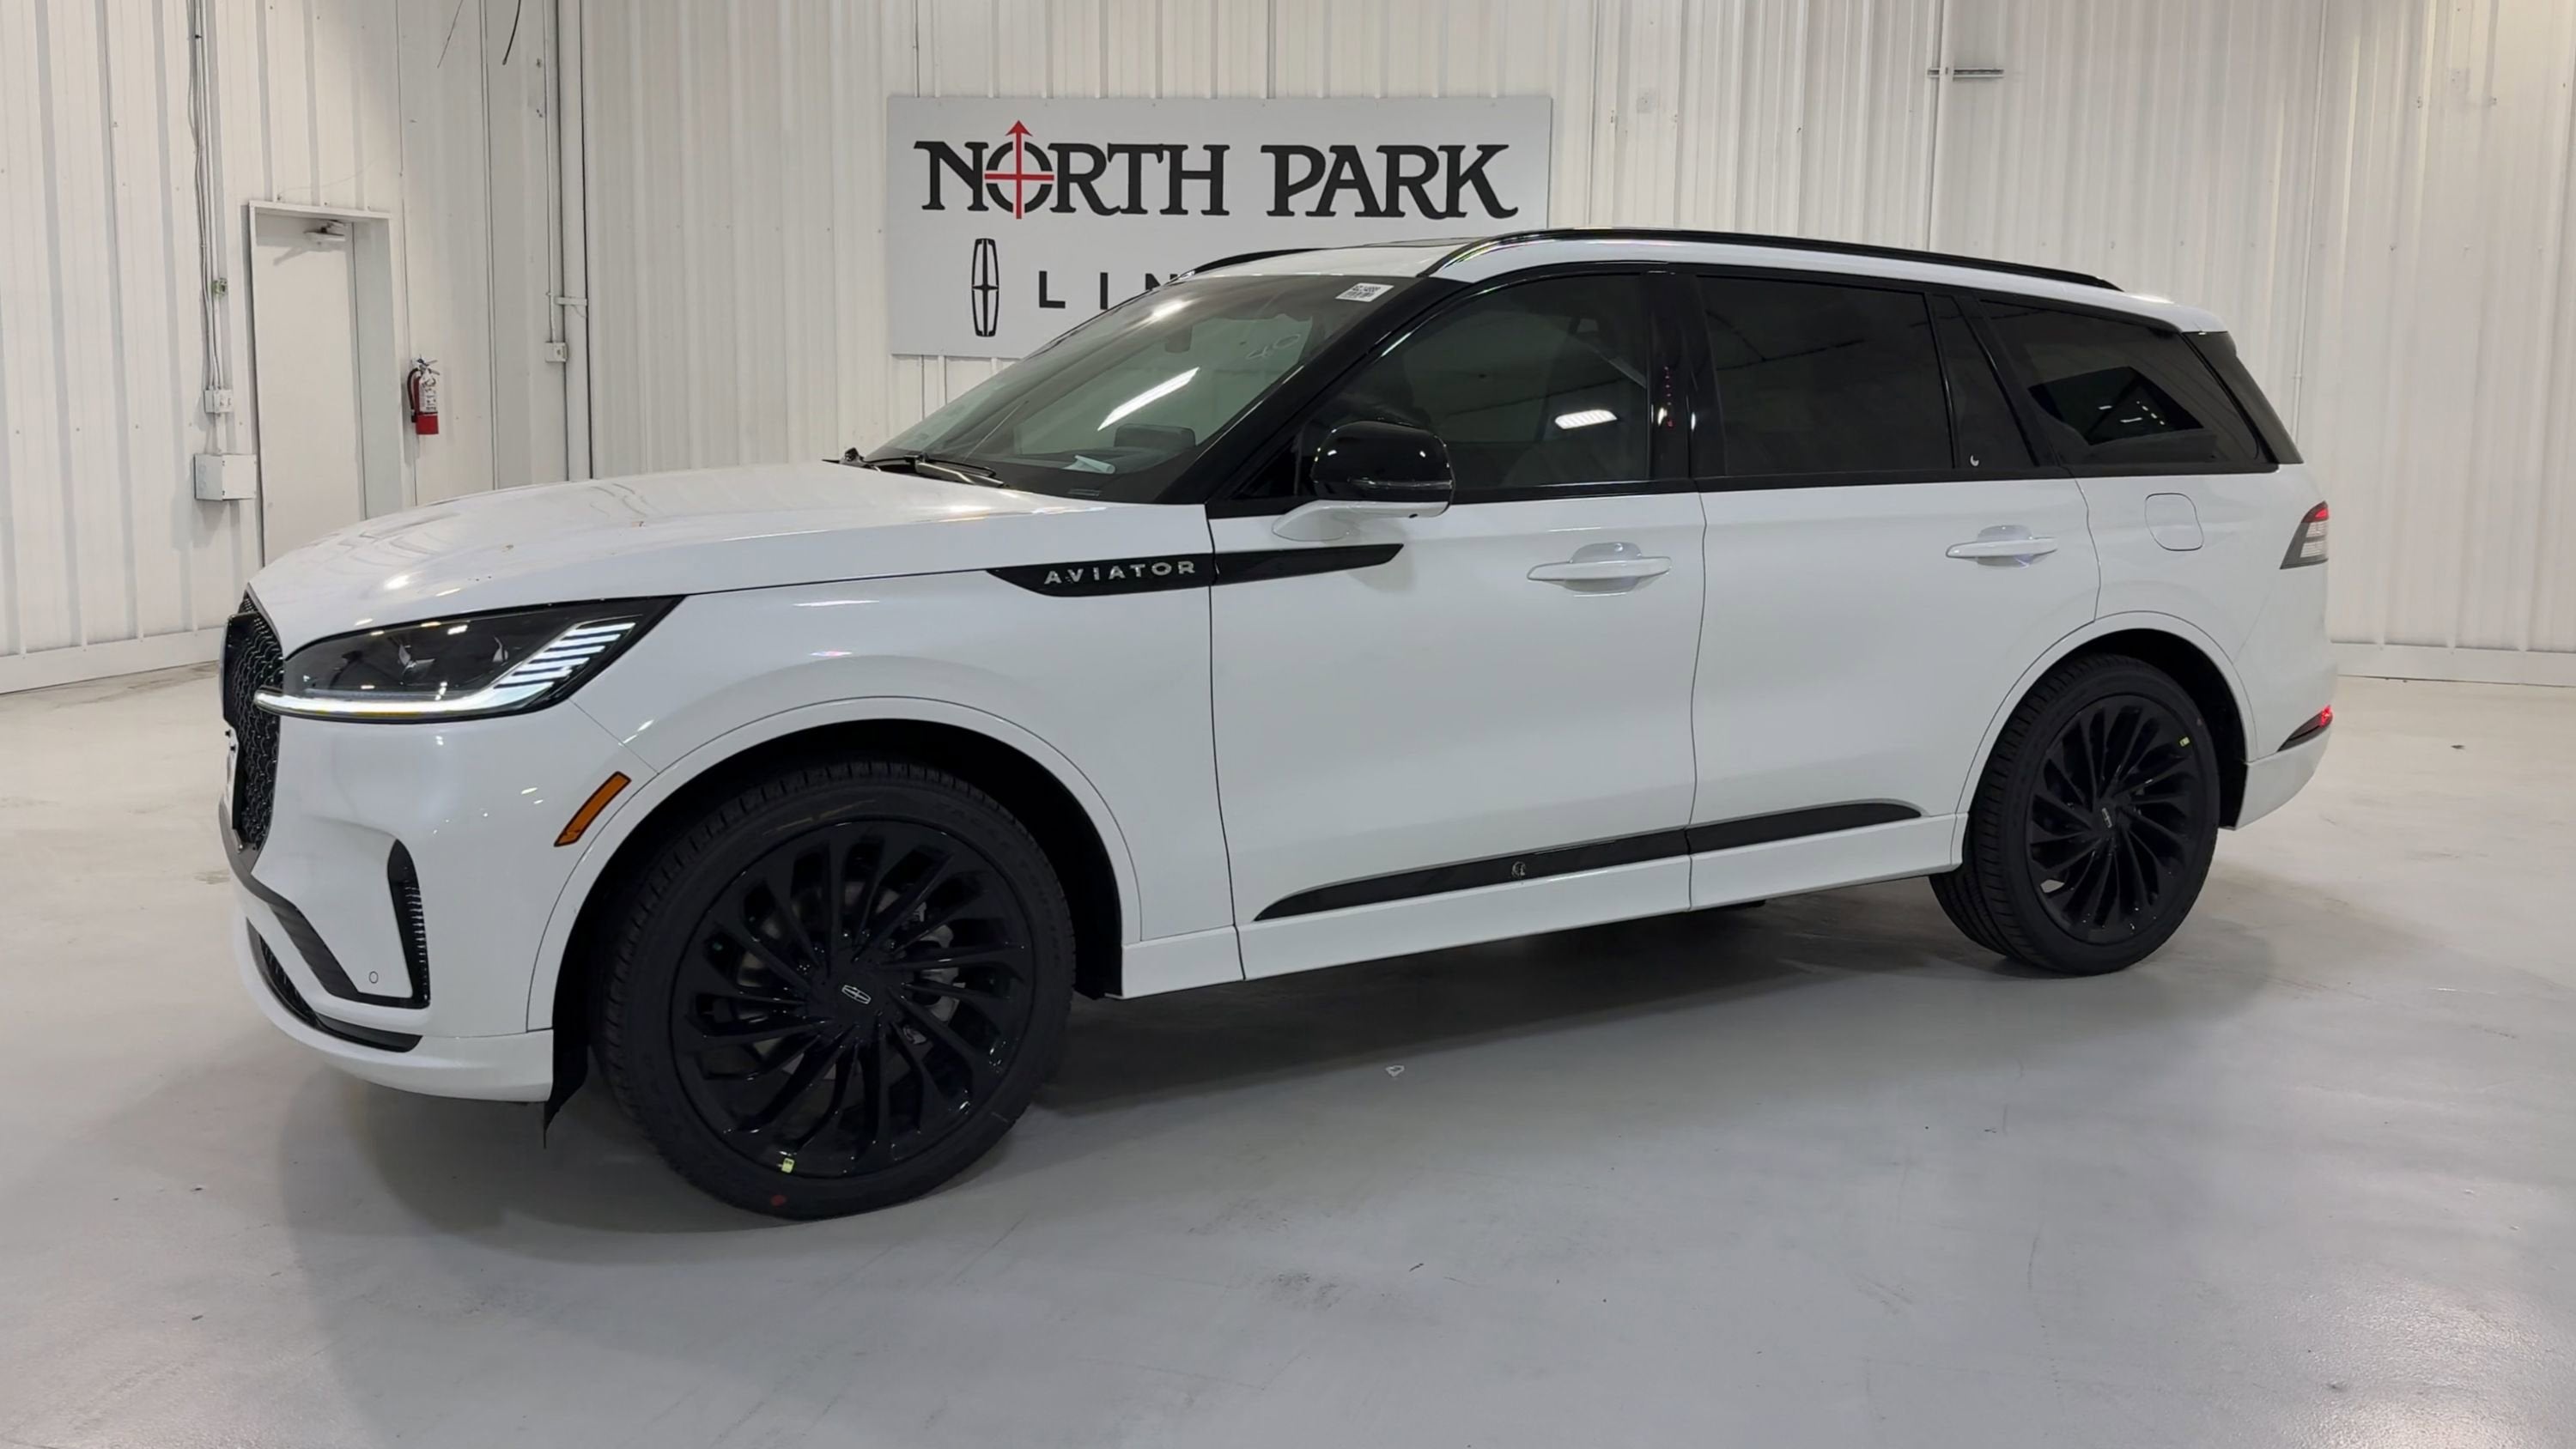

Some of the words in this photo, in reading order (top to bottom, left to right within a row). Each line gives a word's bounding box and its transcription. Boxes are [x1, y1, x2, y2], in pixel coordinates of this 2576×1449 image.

[914, 140, 1230, 217] NORTH
[1261, 144, 1519, 220] PARK
[1043, 561, 1196, 585] AVIATOR
